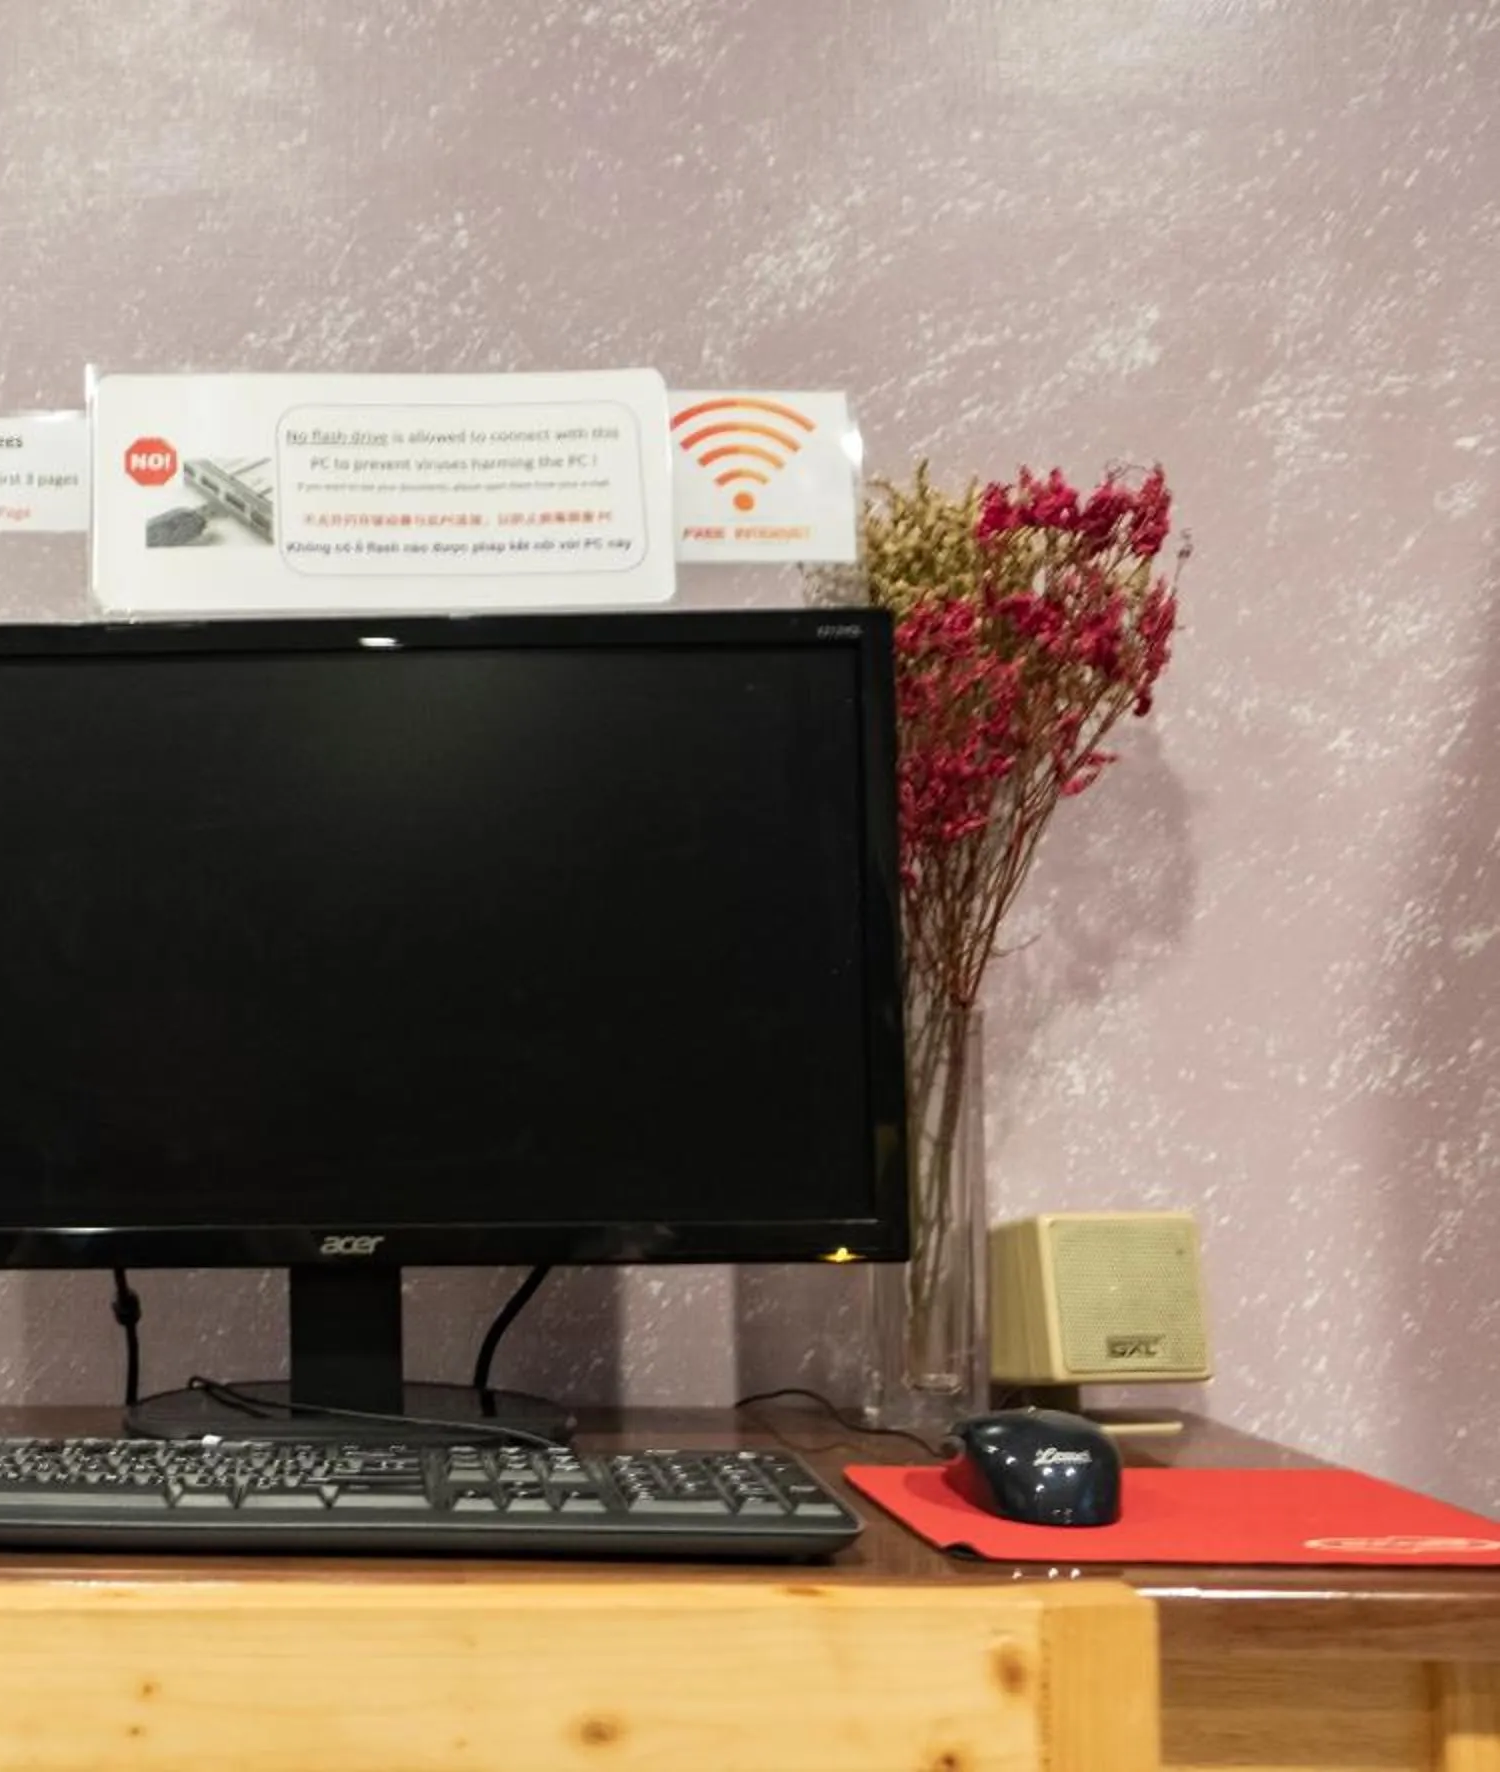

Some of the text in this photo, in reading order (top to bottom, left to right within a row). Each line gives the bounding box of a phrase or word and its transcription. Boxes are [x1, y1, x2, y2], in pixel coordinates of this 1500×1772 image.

[286, 429, 307, 444] No
[312, 428, 347, 444] flash
[351, 429, 388, 445] drive
[408, 429, 466, 443] allowed
[470, 430, 486, 443] to
[490, 430, 549, 441] connect
[556, 428, 588, 440] with
[131, 452, 171, 470] NO!
[310, 456, 329, 470] PC
[334, 458, 349, 470] to
[353, 459, 410, 473] prevent
[414, 459, 468, 470] viruses
[471, 457, 534, 471] harming
[538, 456, 563, 467] the
[568, 455, 588, 467] PC
[37, 475, 79, 489] pages
[320, 1236, 385, 1255] acer
